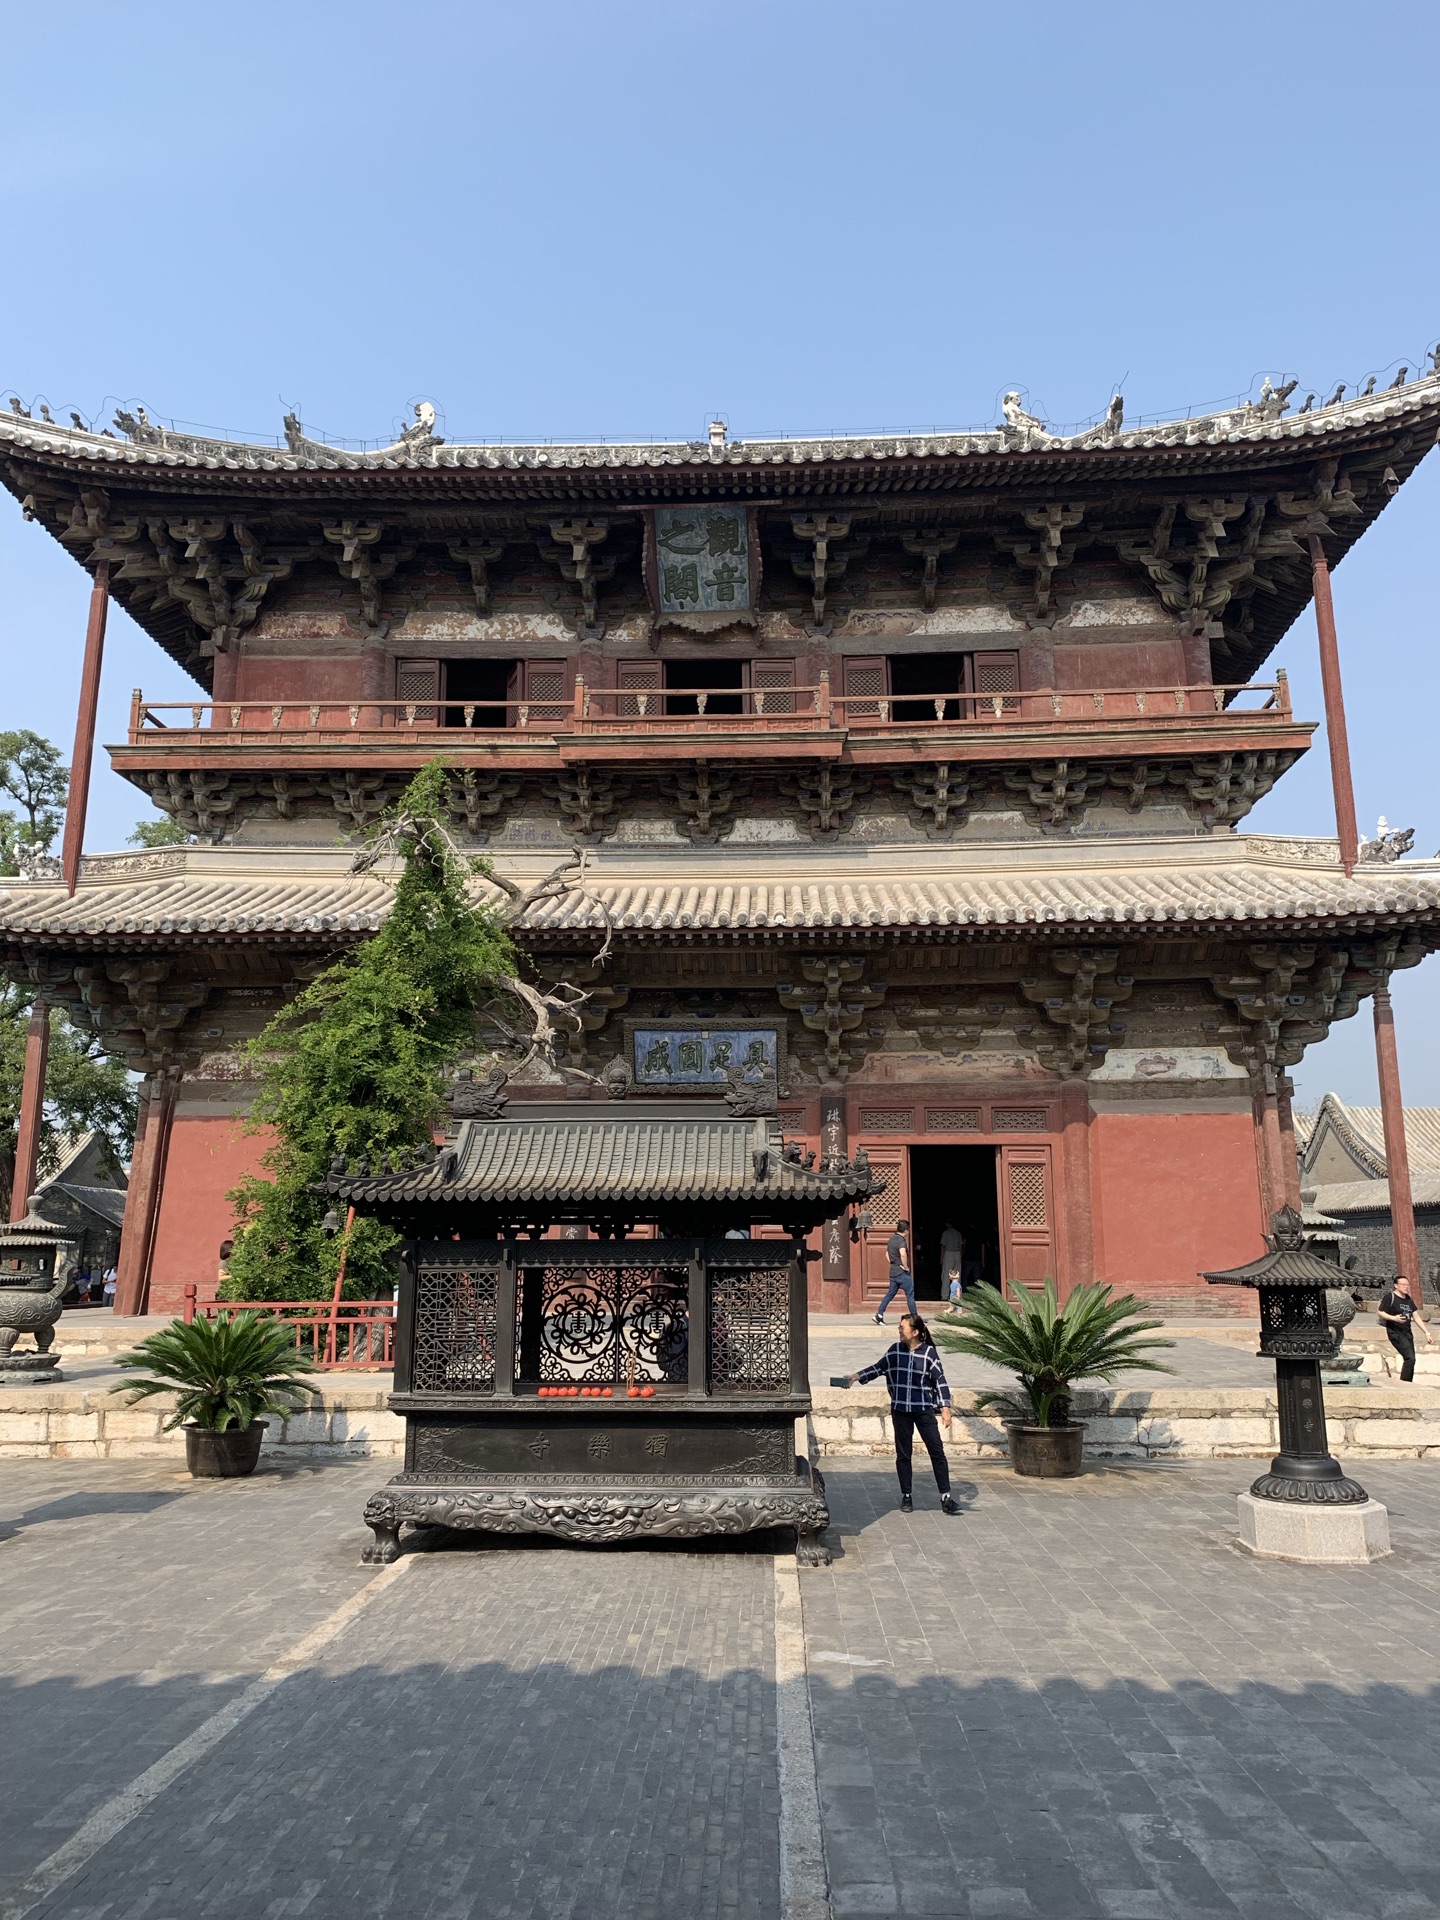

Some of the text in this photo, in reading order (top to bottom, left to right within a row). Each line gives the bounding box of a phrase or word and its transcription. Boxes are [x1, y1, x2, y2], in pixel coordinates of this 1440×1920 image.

[1300, 1378, 1315, 1433] 獨樂寺
[528, 1431, 669, 1460] 獨樂寺
